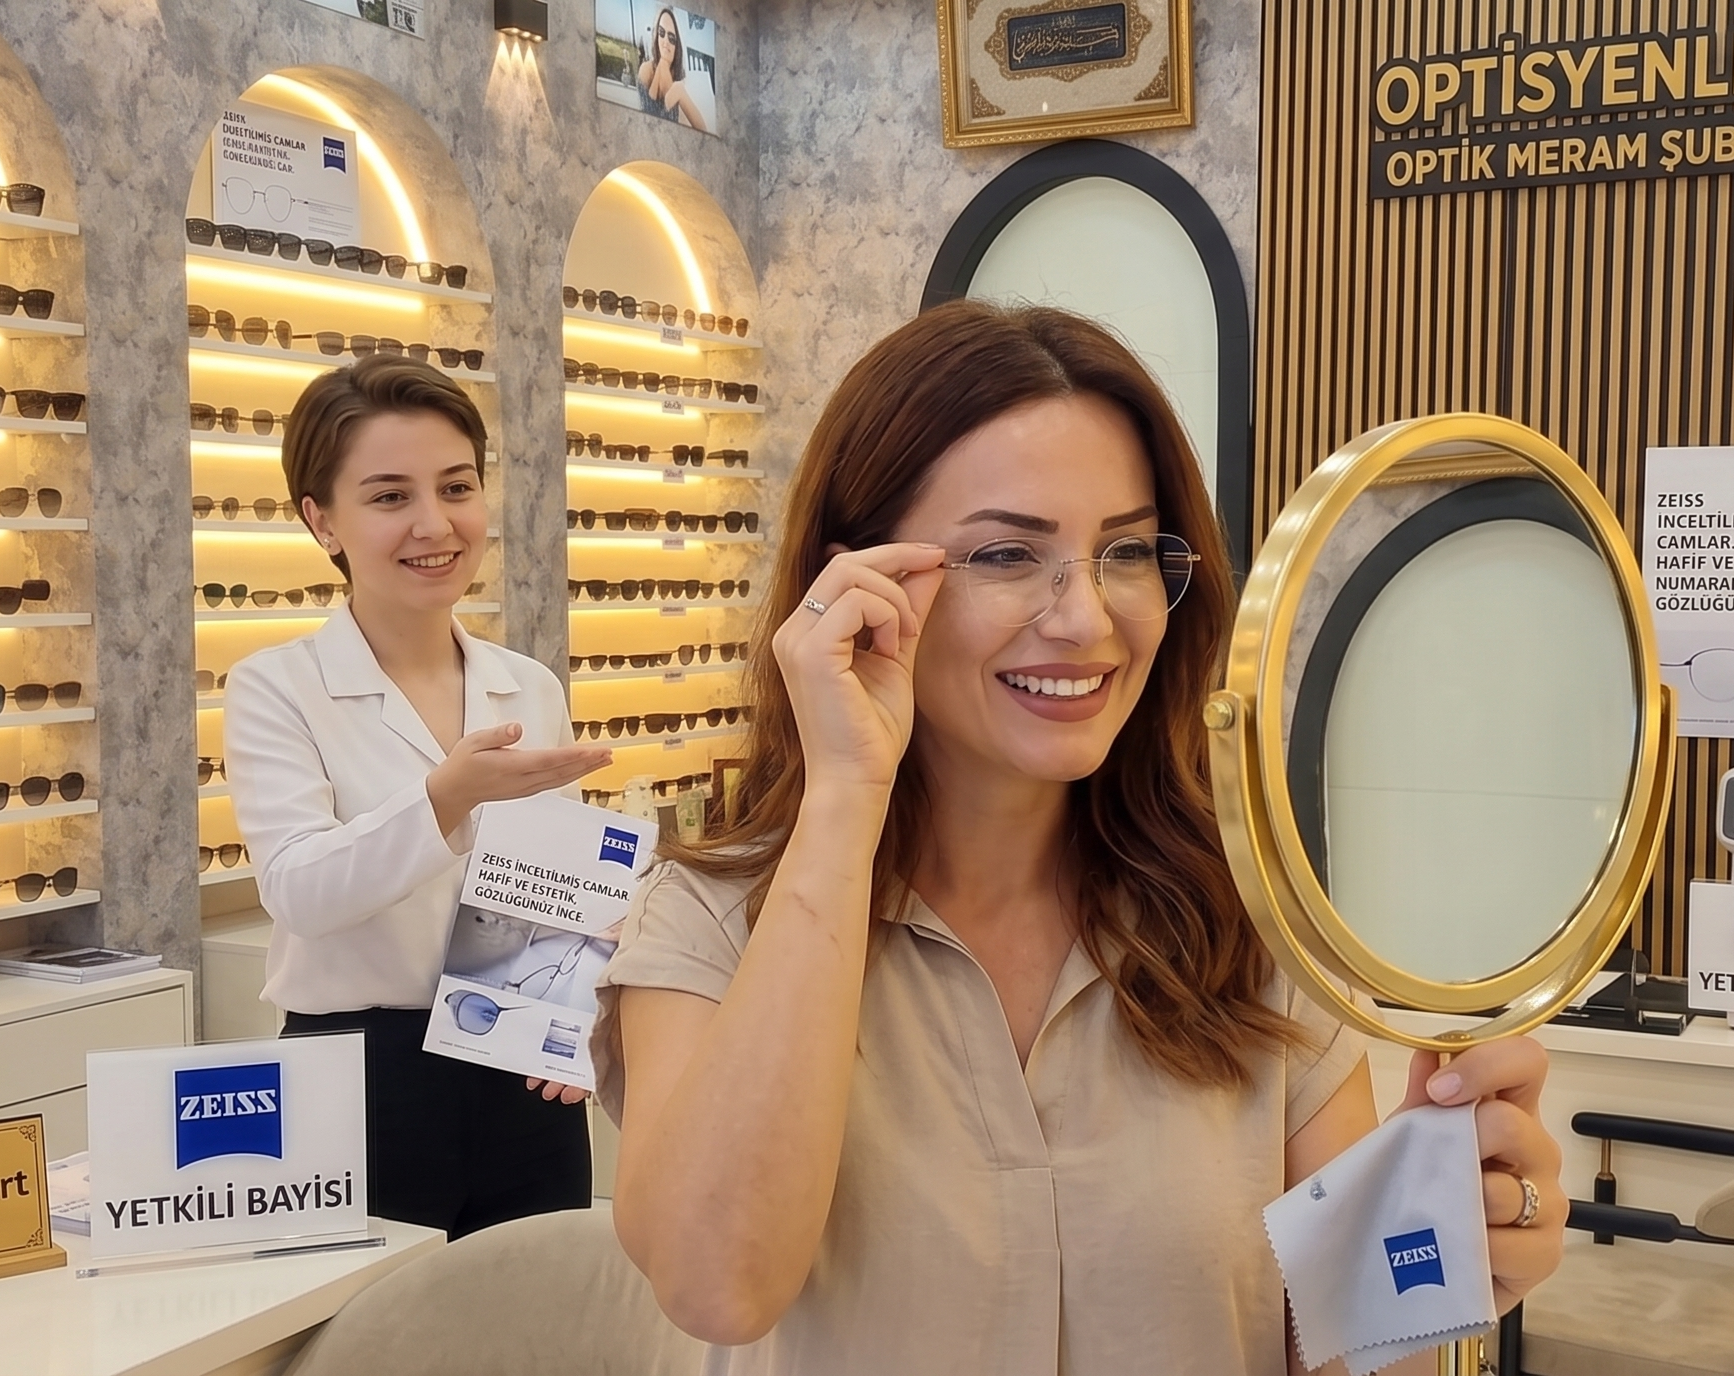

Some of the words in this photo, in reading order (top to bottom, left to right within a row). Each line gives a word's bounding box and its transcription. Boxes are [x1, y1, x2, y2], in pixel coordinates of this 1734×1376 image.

[1376, 35, 1729, 126] OPTİSYENL
[274, 135, 306, 151] CAMLAR
[1386, 137, 1497, 187] OPTİK
[1506, 132, 1648, 178] MERAM
[1659, 126, 1734, 172] ŞUB
[1657, 493, 1704, 508] ZEISS
[1658, 511, 1734, 528] İNCELTİL
[1656, 552, 1707, 570] HAFİF
[1712, 556, 1734, 570] VE
[1656, 576, 1734, 590] NUMARA
[603, 836, 636, 853] ZEISS
[481, 852, 513, 870] ZEISS
[582, 880, 630, 902] CAMLAR.
[514, 878, 530, 892] VE
[531, 882, 577, 905] ESTETİK,
[179, 1088, 277, 1121] ZEISS
[0, 1170, 30, 1199] rt
[105, 1182, 235, 1229] YETKİLİ
[247, 1170, 353, 1216] BAYİSİ
[1390, 1244, 1438, 1268] ZEISS
